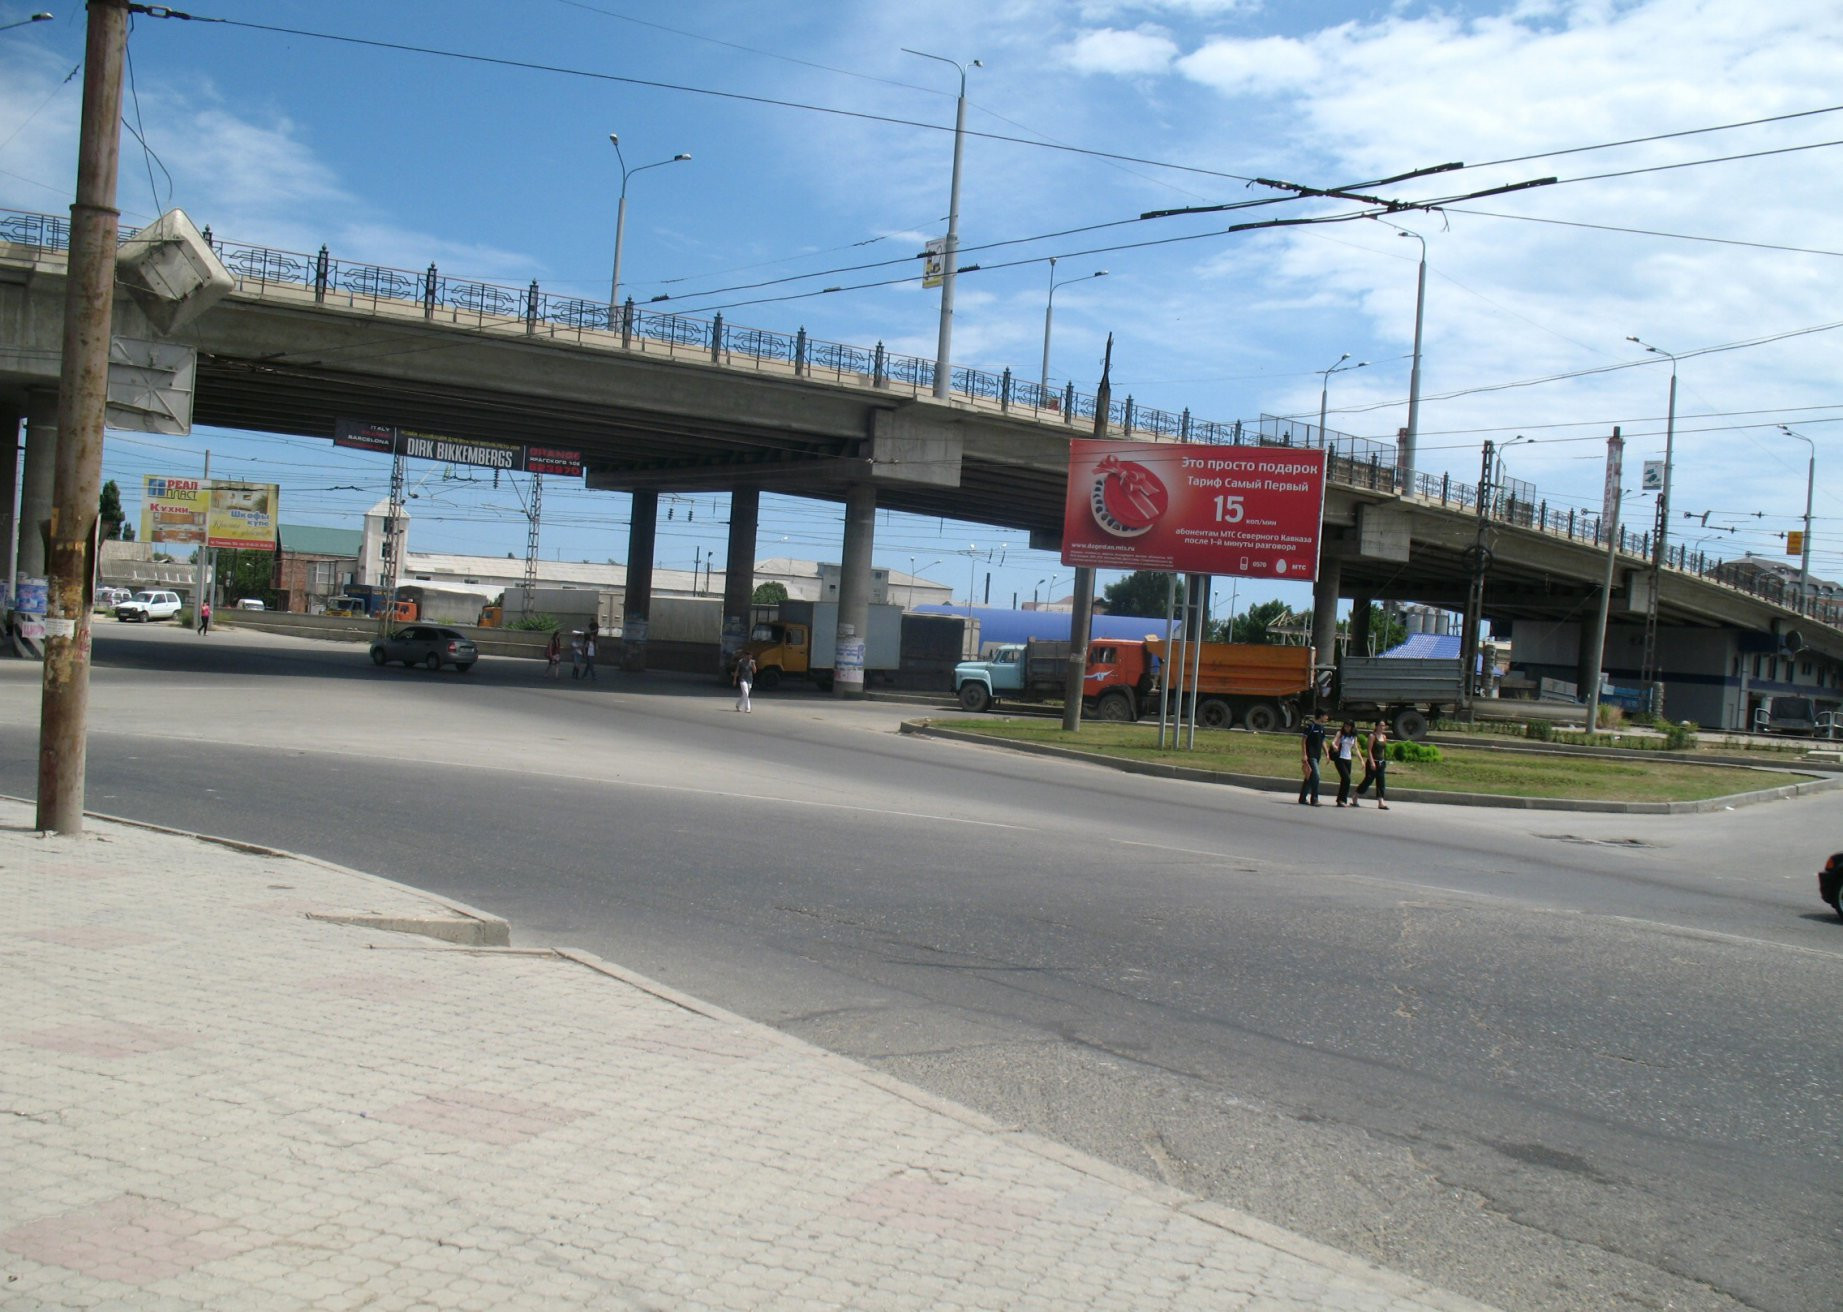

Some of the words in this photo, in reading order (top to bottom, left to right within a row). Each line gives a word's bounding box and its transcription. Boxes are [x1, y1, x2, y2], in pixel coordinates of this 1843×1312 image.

[347, 434, 389, 445] BARCELONA
[407, 437, 433, 458] DIRK
[436, 442, 513, 468] BIKKEMBERGS
[1181, 456, 1204, 468] Это
[1207, 459, 1255, 471] просто
[1258, 462, 1318, 475] подарок
[167, 479, 199, 490] РЕАЛ
[1187, 475, 1222, 488] Тариф
[1224, 478, 1261, 489] Самый
[1264, 480, 1309, 492] Первый
[166, 488, 197, 501] ПЛАСТ
[231, 510, 270, 521] Шкафы
[1214, 495, 1245, 523] 15
[1175, 527, 1219, 537] абонентам
[1220, 530, 1236, 538] МТС
[1237, 531, 1279, 541] Северного
[1280, 534, 1312, 543] Кавказа
[1223, 540, 1254, 549] минуты
[1255, 542, 1297, 551] разговора
